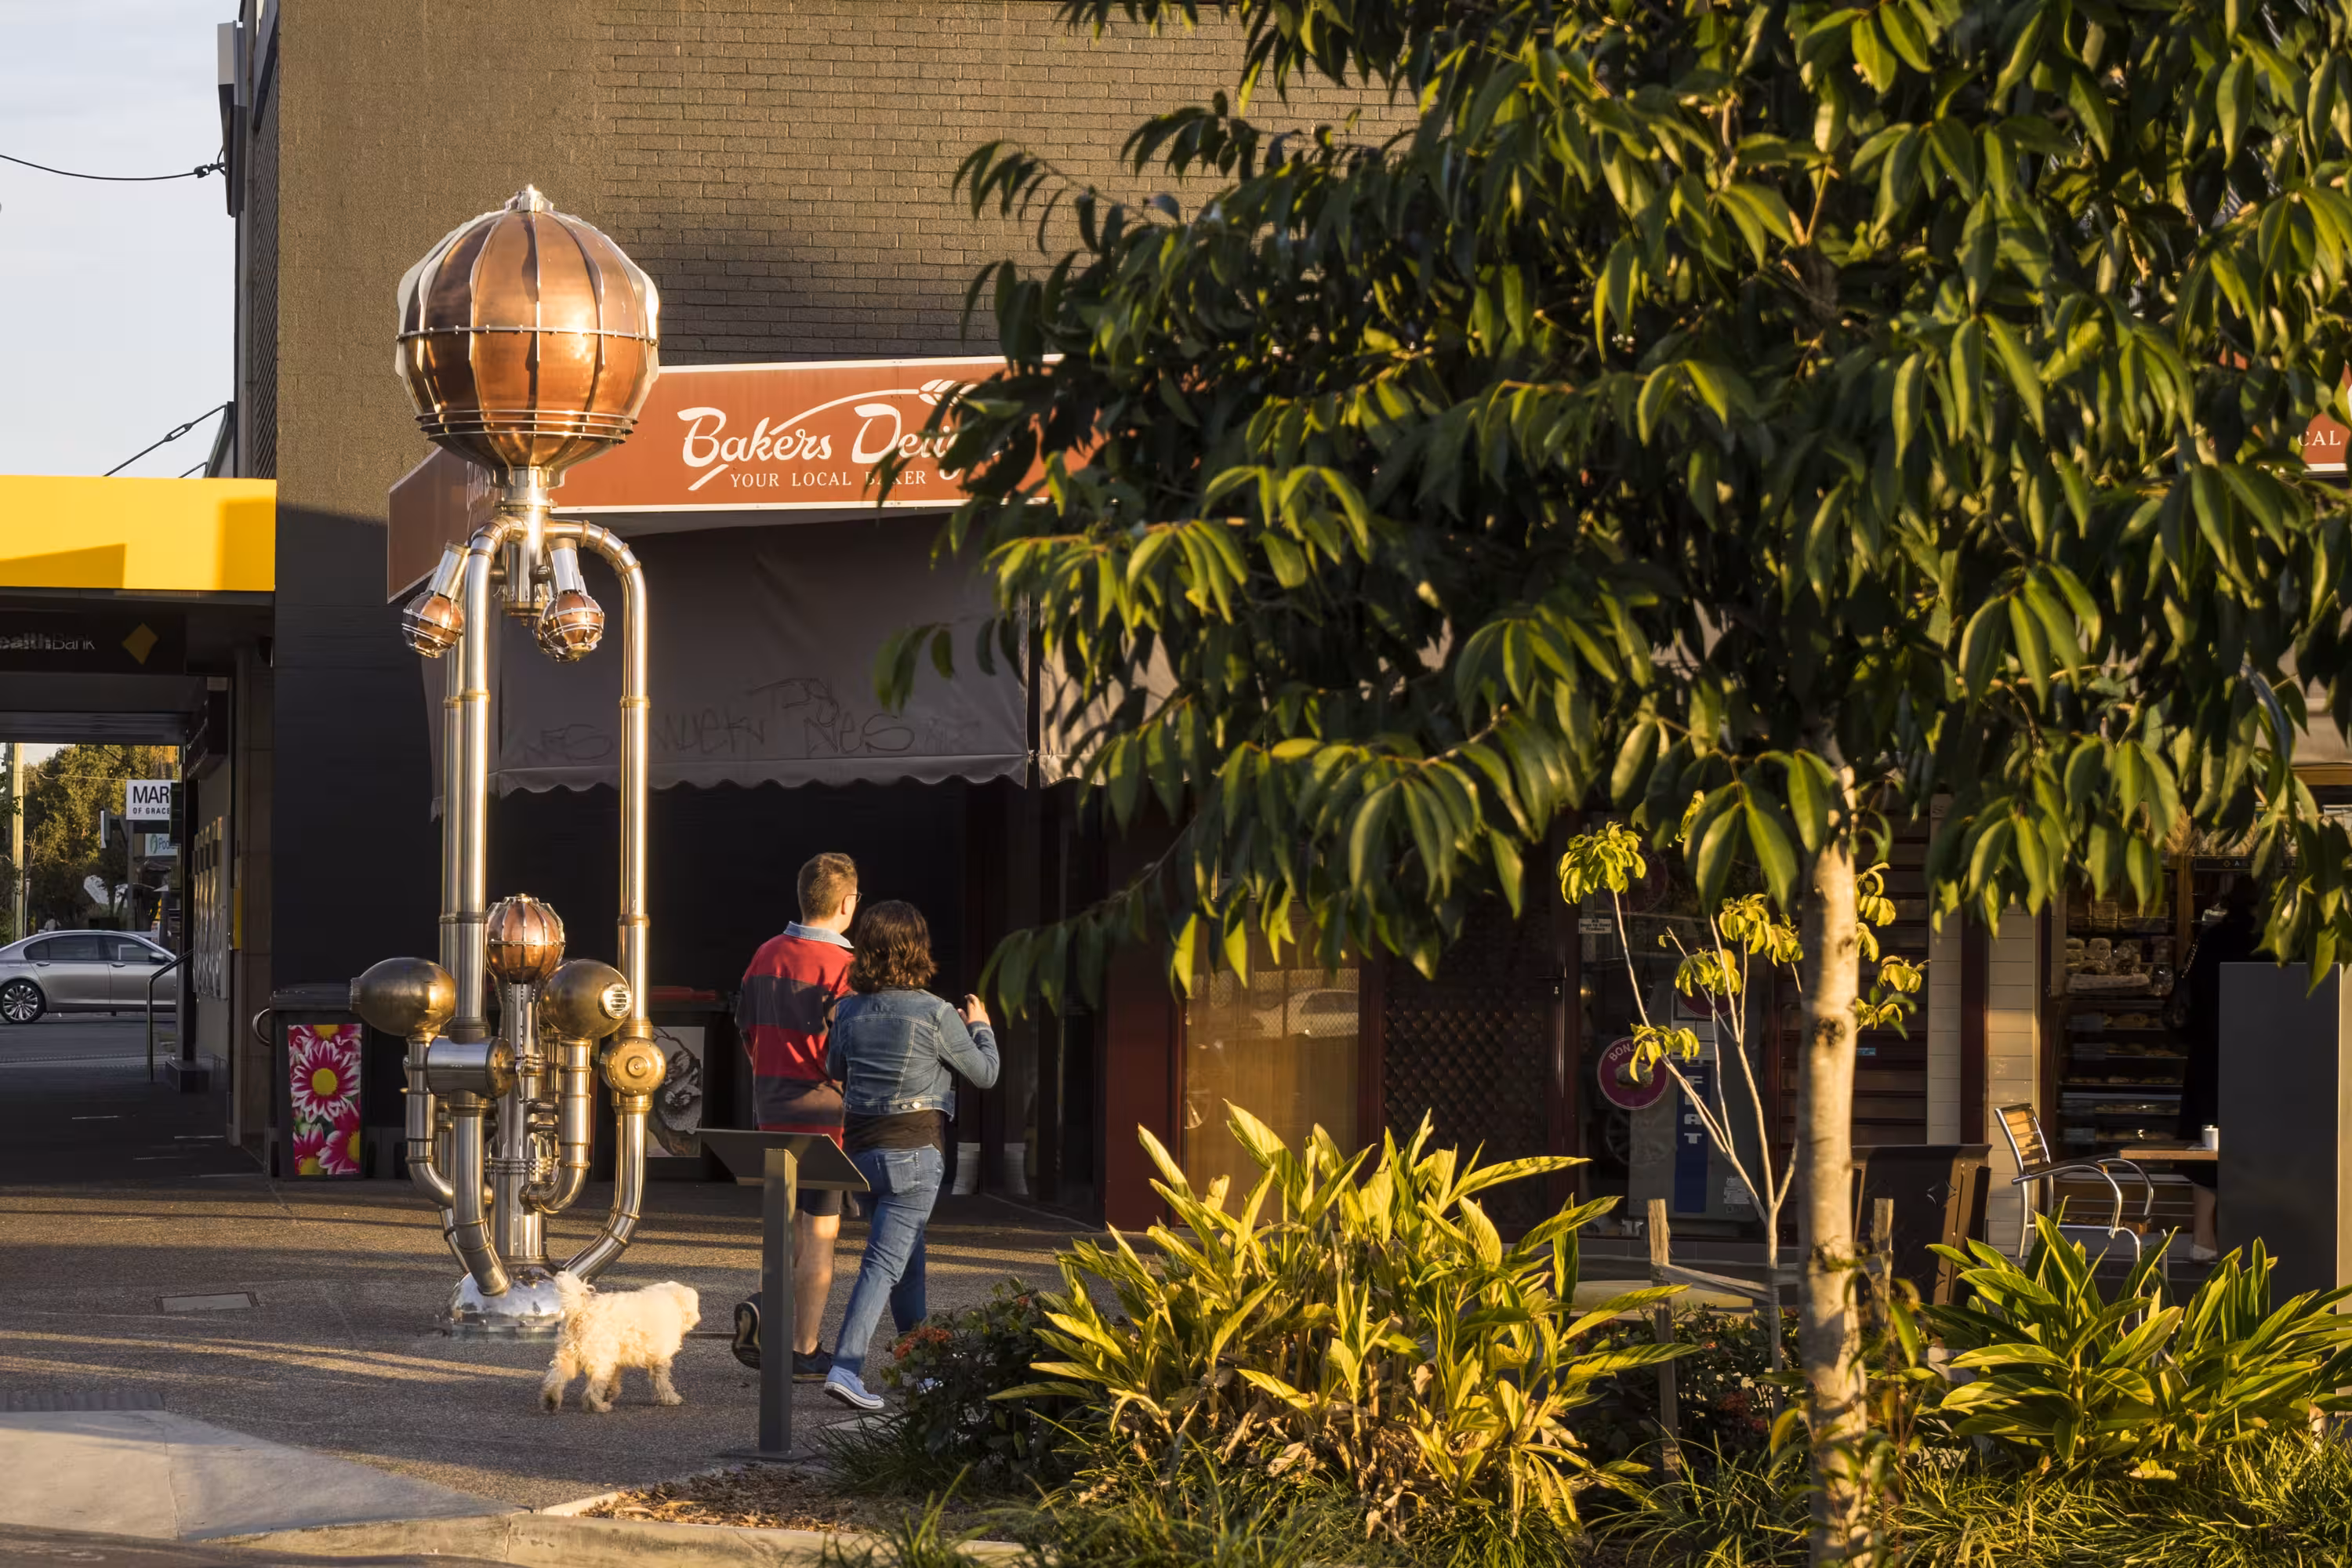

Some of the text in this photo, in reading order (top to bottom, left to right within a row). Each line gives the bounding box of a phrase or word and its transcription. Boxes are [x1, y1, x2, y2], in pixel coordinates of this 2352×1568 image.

[677, 406, 832, 468] Bakers
[2297, 430, 2341, 446] CAL
[731, 473, 779, 487] YOUR
[792, 471, 851, 487] LOCAL
